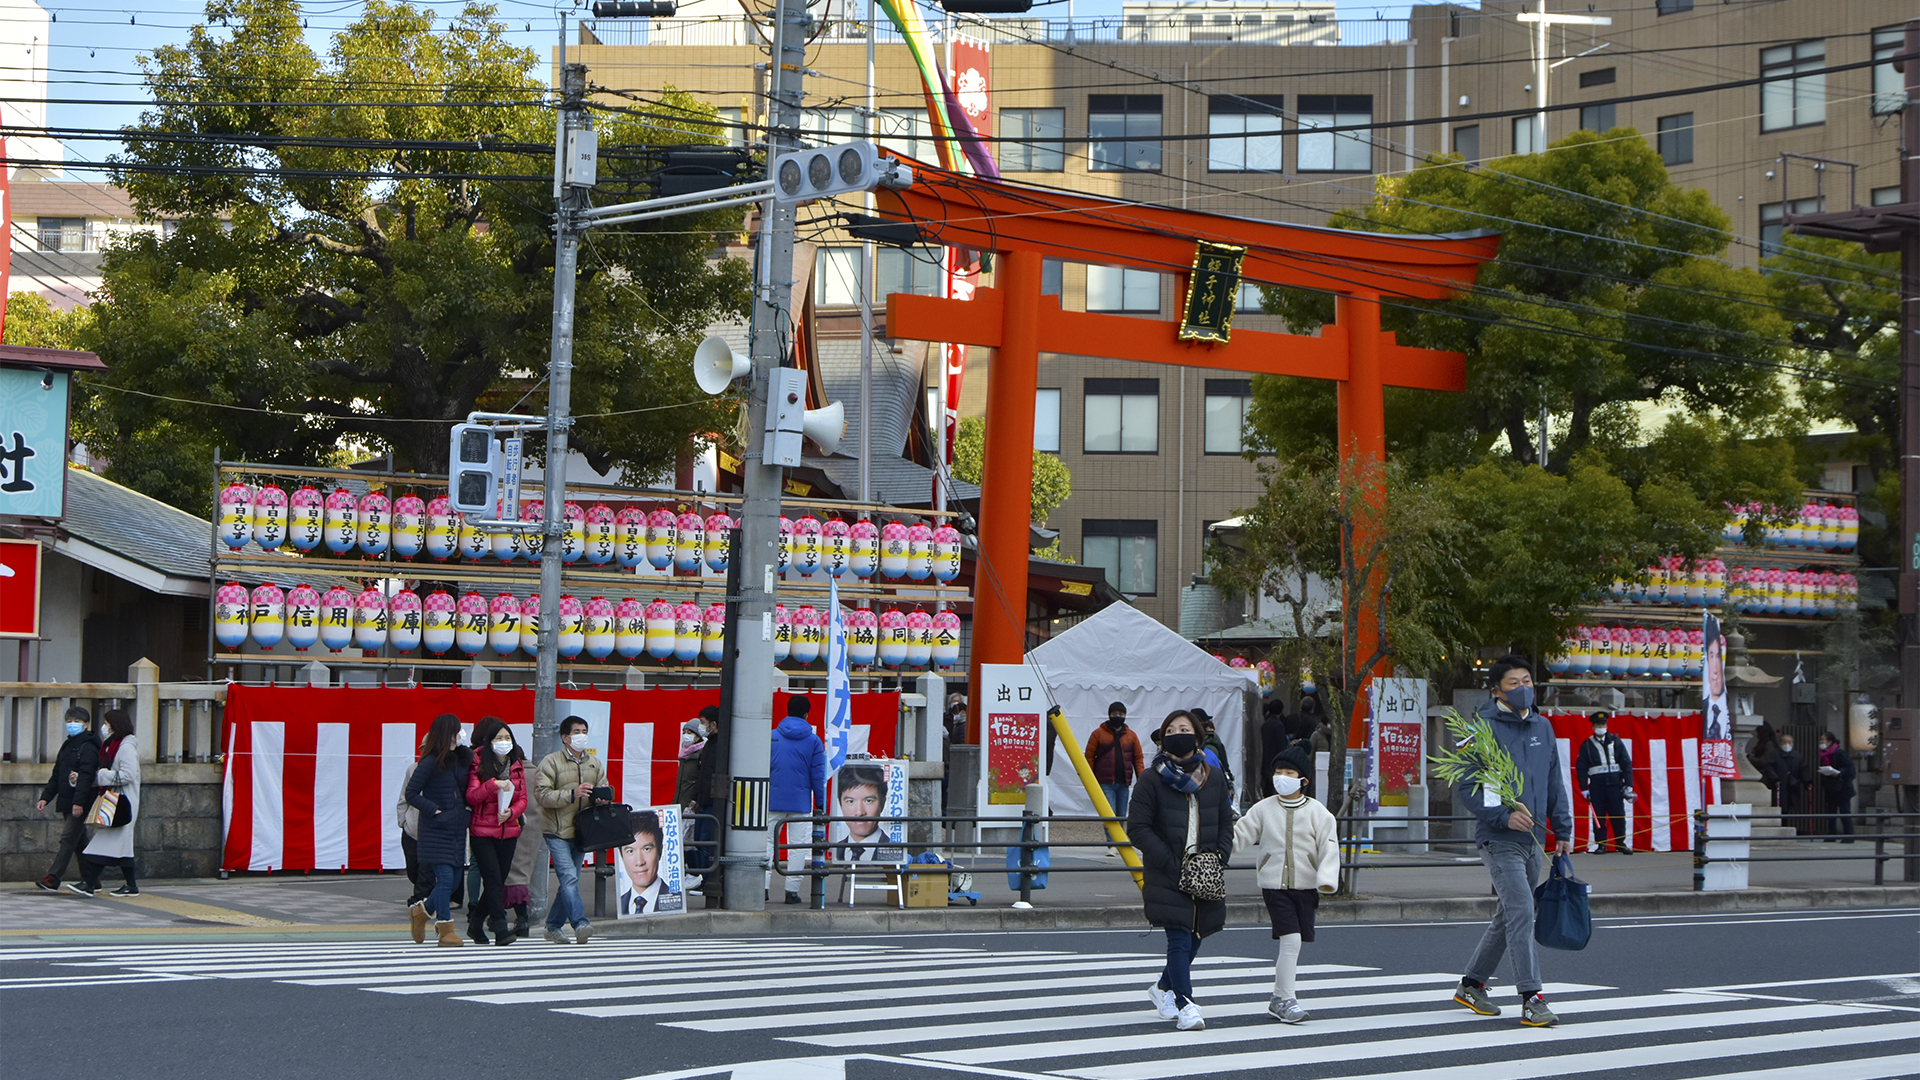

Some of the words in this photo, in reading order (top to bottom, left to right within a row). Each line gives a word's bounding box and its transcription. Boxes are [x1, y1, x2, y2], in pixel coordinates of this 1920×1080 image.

[232, 498, 248, 540] 十日えびす
[264, 500, 280, 542] 十日えびす
[305, 500, 320, 543] 十日えびす
[340, 504, 354, 545] 十日えびす
[366, 506, 382, 547] 十日えびす
[444, 510, 457, 552] 十日えびす
[597, 518, 611, 558] 十日えびす
[624, 519, 639, 560] 十日えびす
[665, 521, 676, 561] 十日えびす
[805, 529, 818, 568] 十日えびす
[831, 531, 845, 570] 十日えびす
[997, 683, 1032, 702] 出口
[1386, 696, 1415, 712] 出口
[990, 717, 1037, 740] 十日えびす
[1381, 725, 1420, 747] 十日えびす
[665, 810, 681, 893] ふなかわ治郎
